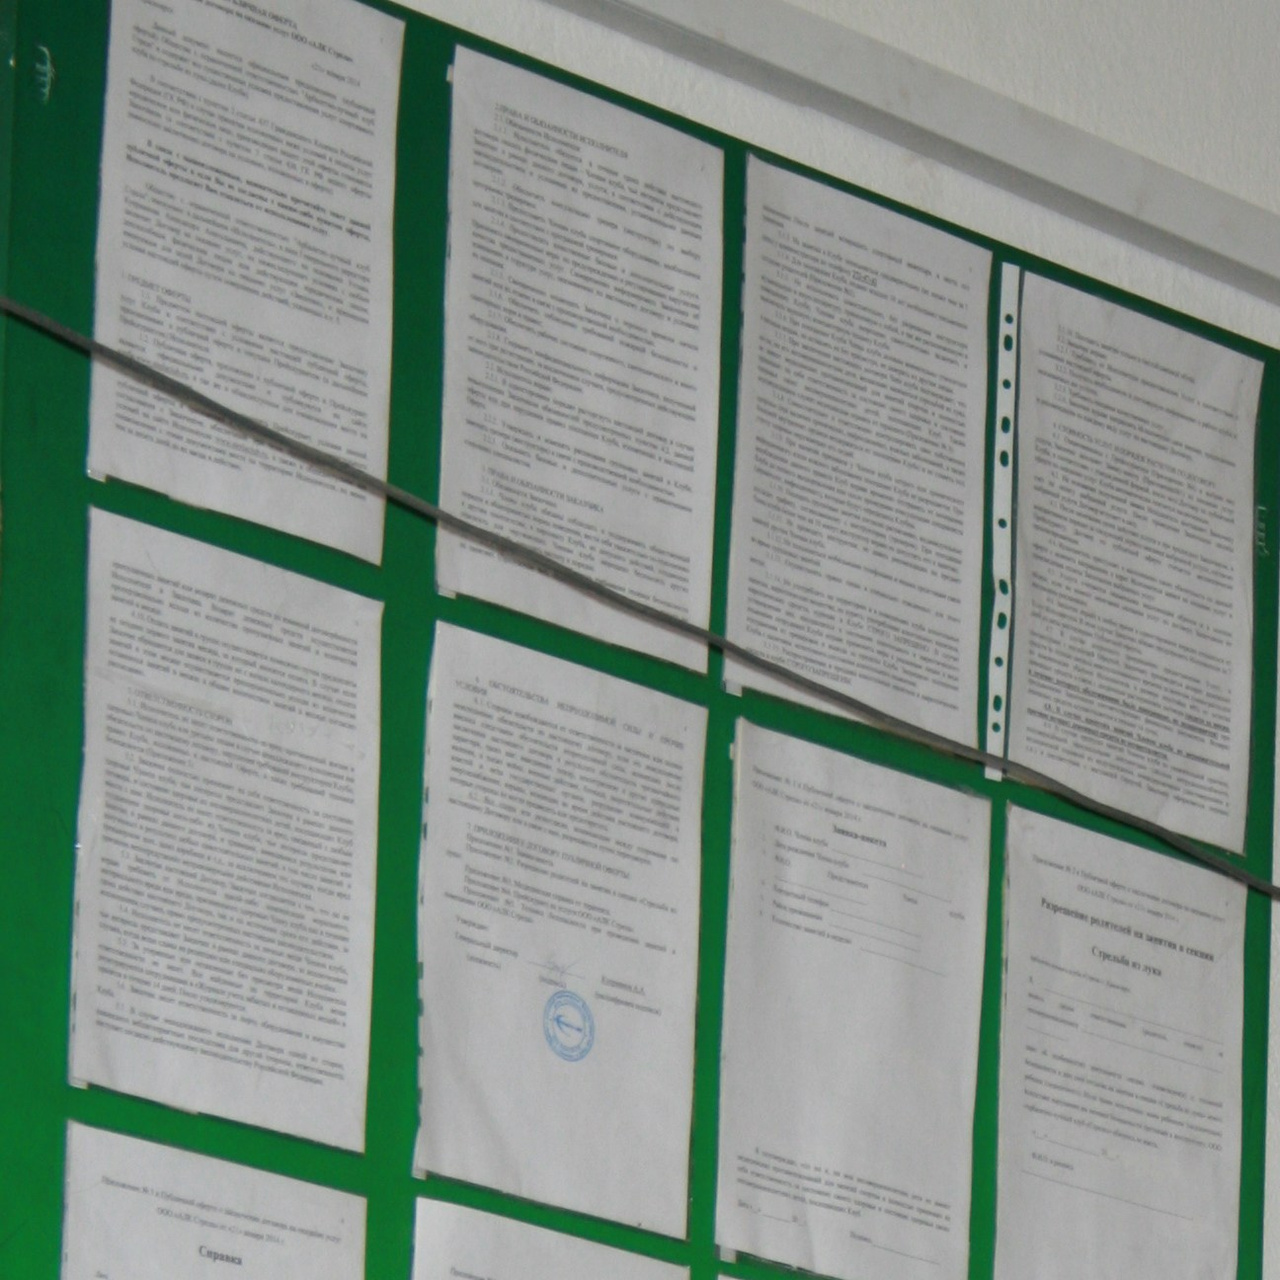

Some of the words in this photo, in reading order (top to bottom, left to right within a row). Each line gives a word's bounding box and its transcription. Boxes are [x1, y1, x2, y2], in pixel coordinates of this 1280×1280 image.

[1090, 916, 1132, 936] родителей
[1091, 946, 1130, 967] Стрельба
[198, 1245, 242, 1265] Справка
